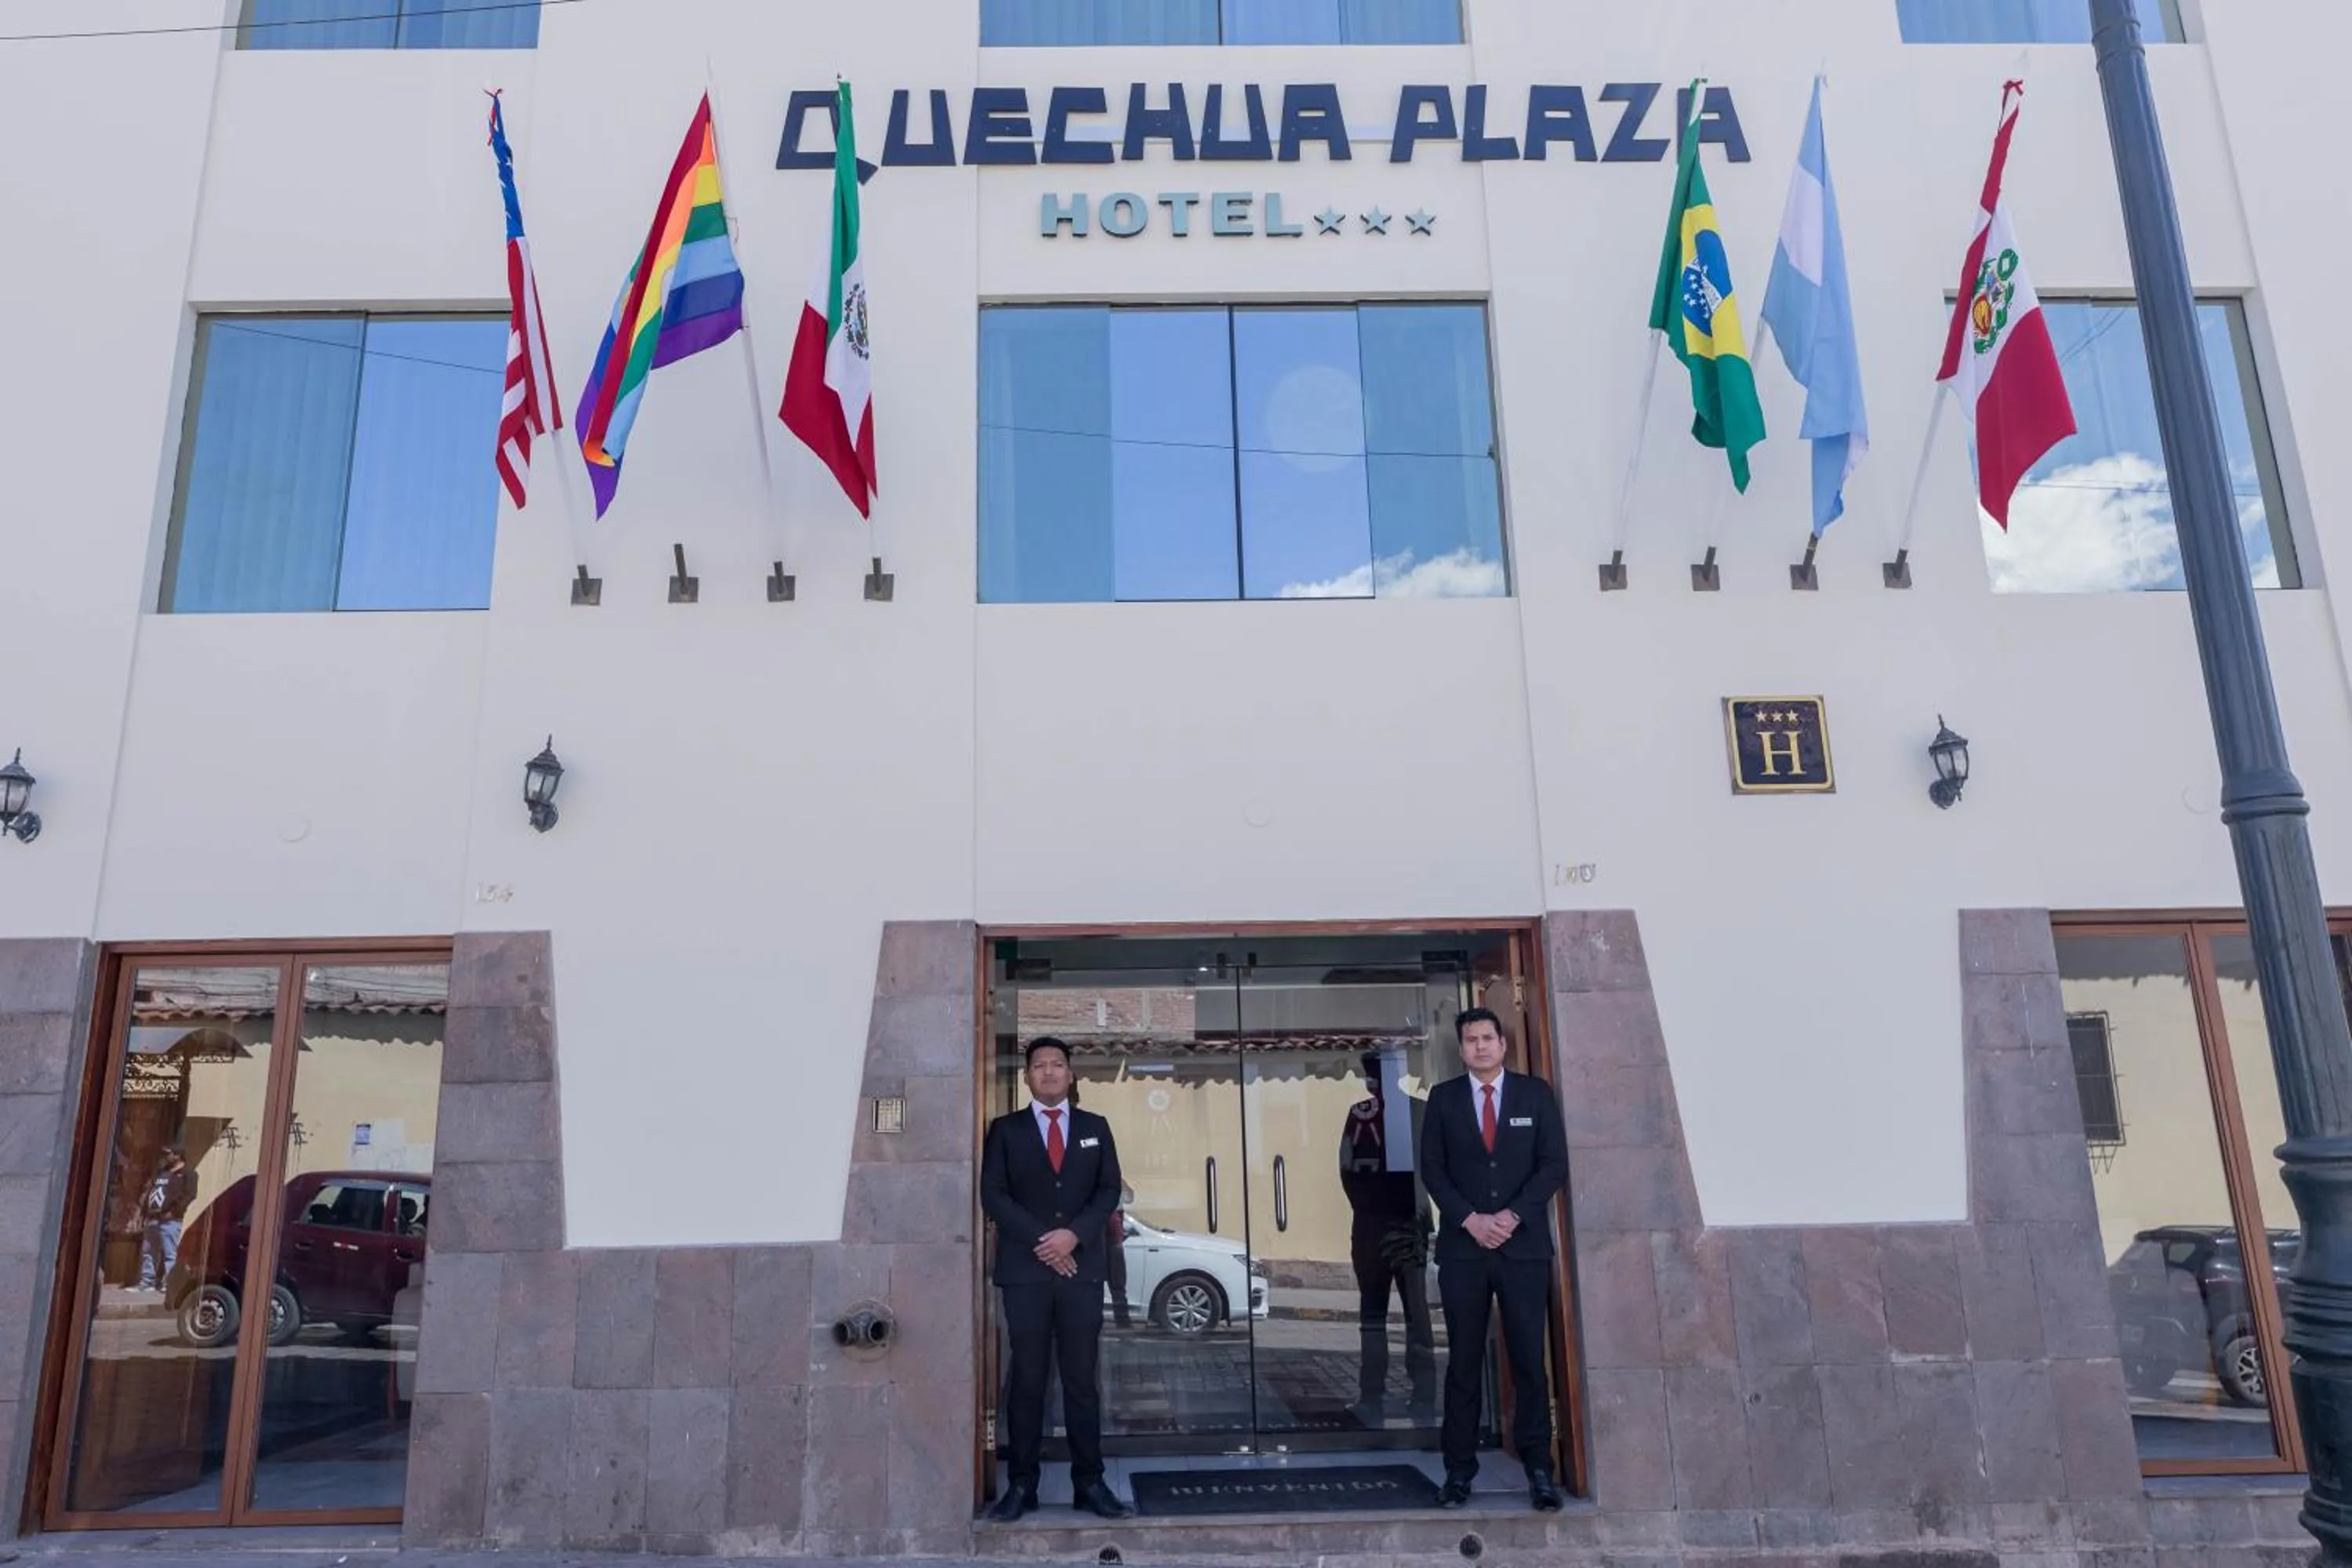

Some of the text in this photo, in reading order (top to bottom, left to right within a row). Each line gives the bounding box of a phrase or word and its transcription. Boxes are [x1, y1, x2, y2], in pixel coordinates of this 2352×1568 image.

[776, 82, 1751, 186] QUECHUA PLAZA
[1041, 192, 1303, 238] HOTEL
[1755, 731, 1807, 775] H
